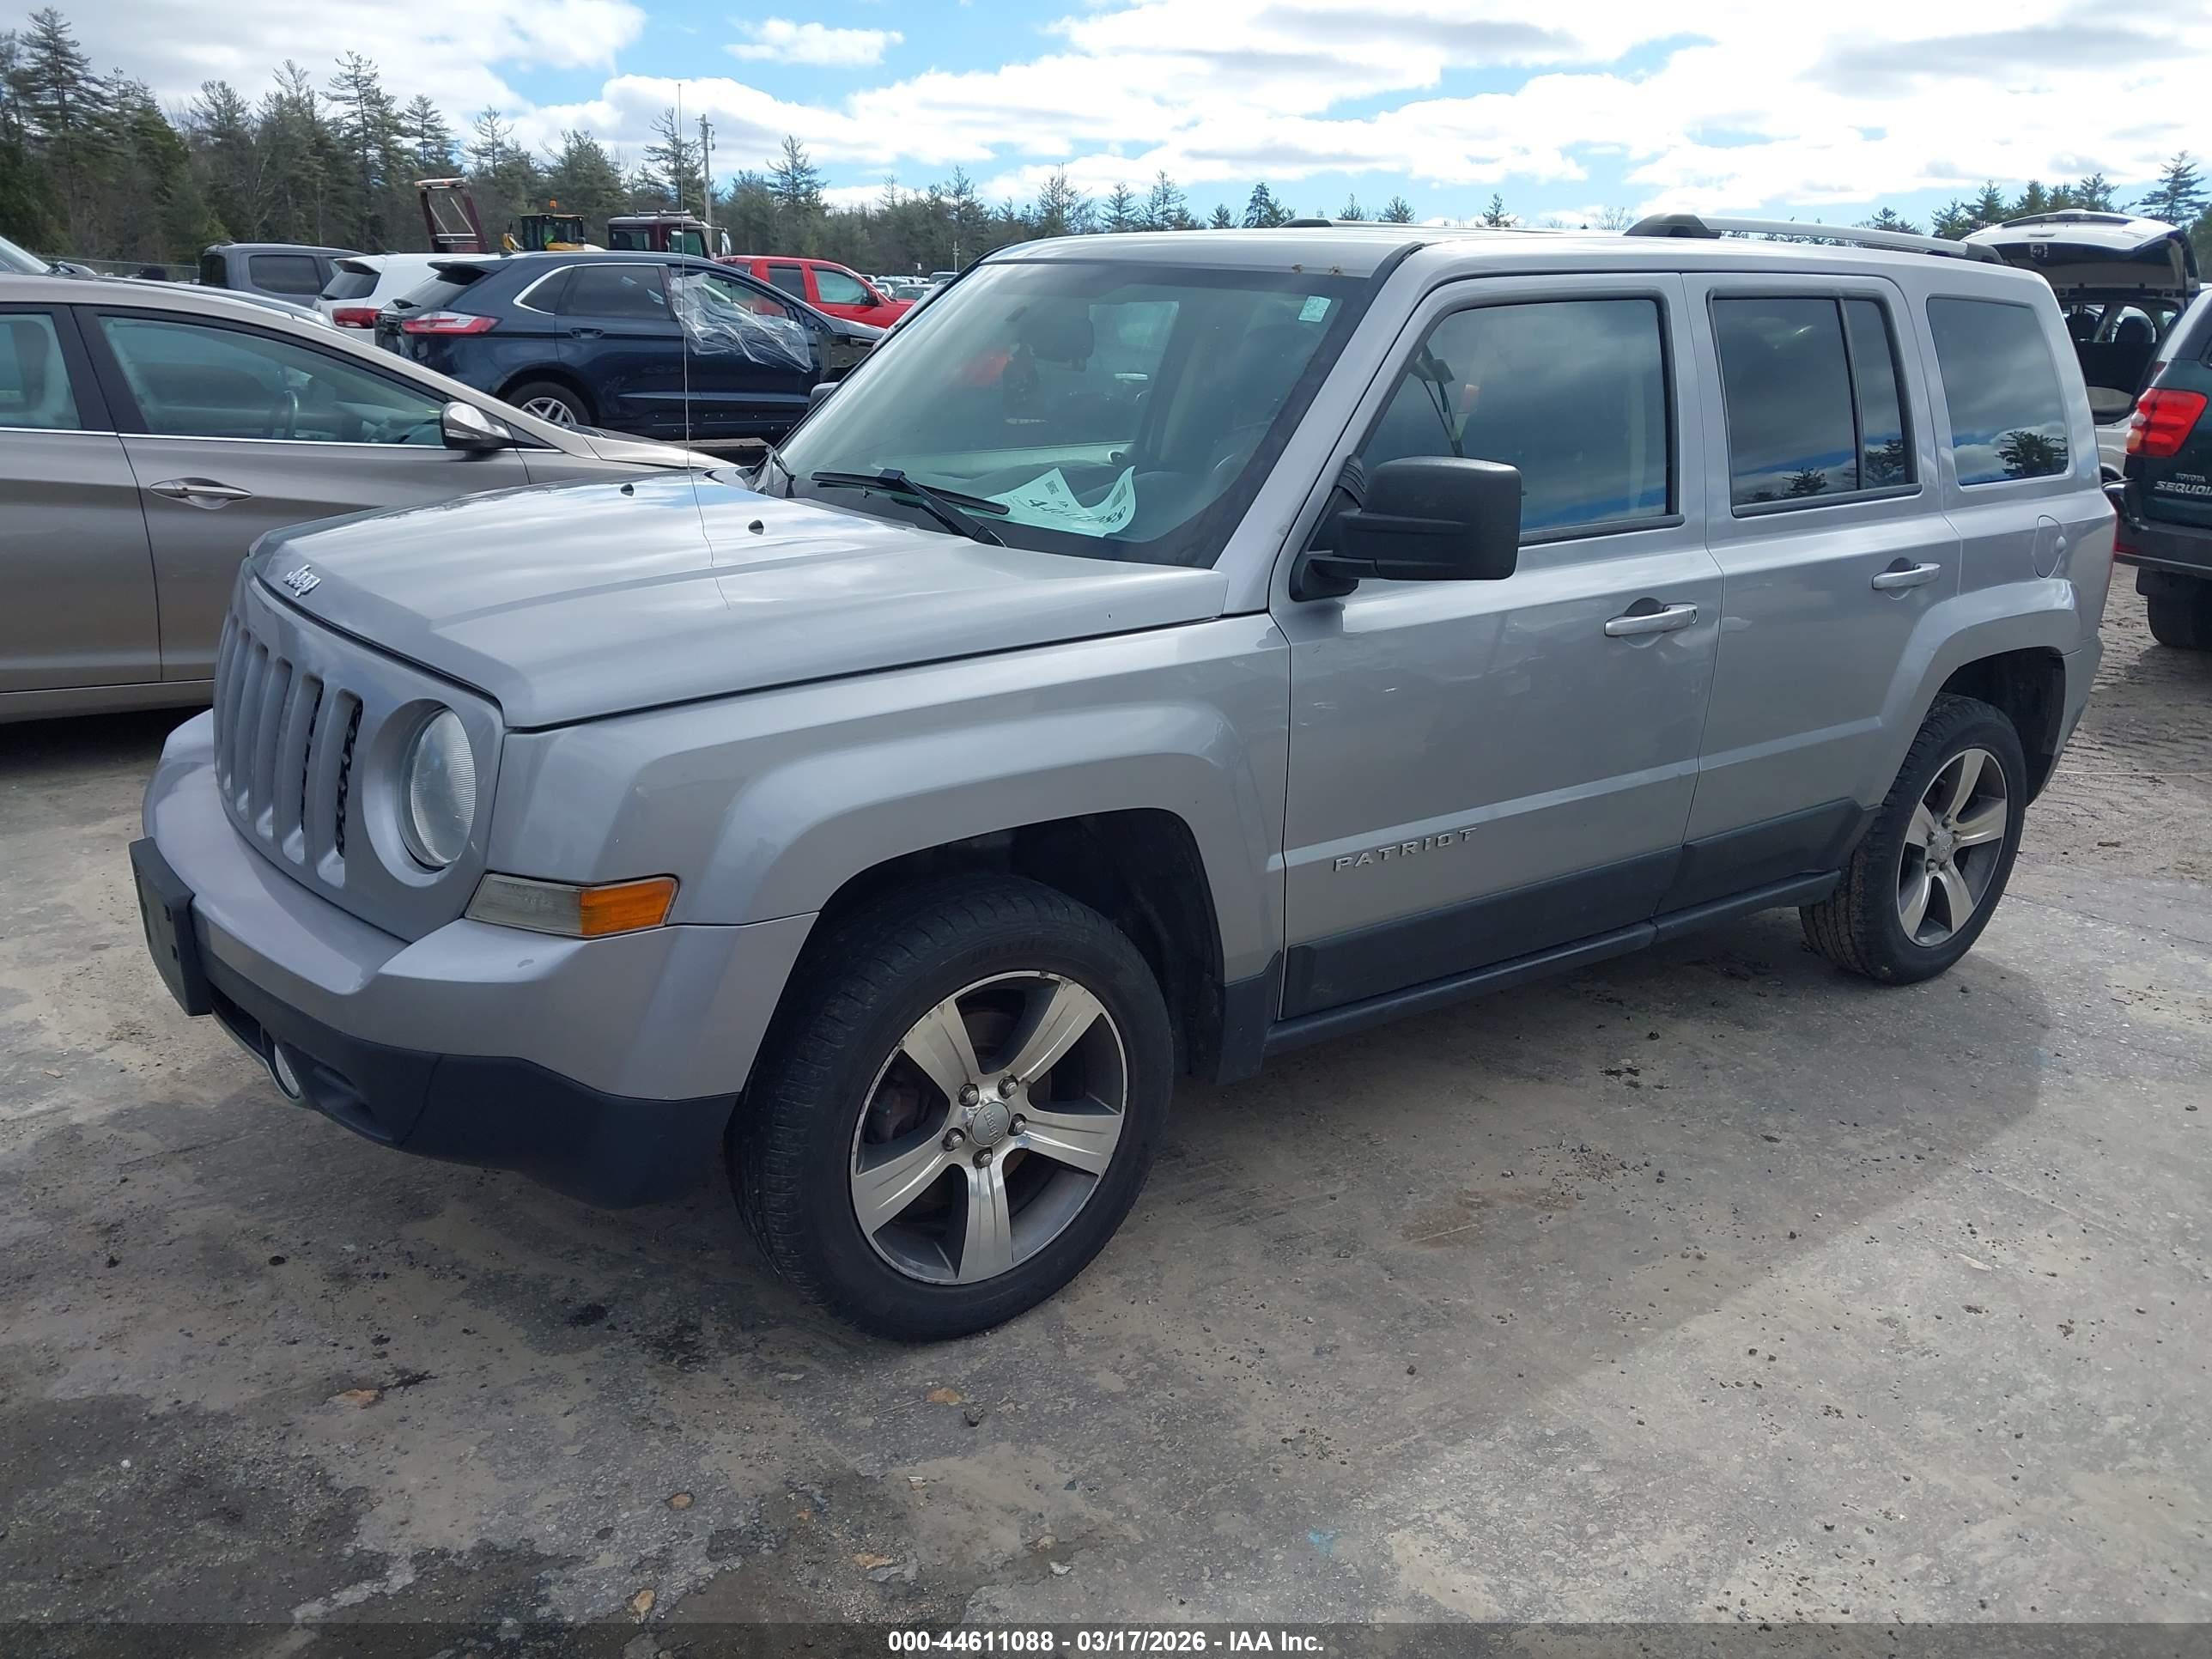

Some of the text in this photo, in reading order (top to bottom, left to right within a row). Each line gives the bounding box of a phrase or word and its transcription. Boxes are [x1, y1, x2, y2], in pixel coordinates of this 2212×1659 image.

[2154, 481, 2212, 495] SEQUOI
[2175, 472, 2206, 483] TOYOTA
[283, 563, 322, 598] Jeep
[1333, 827, 1477, 872] PATRIOT
